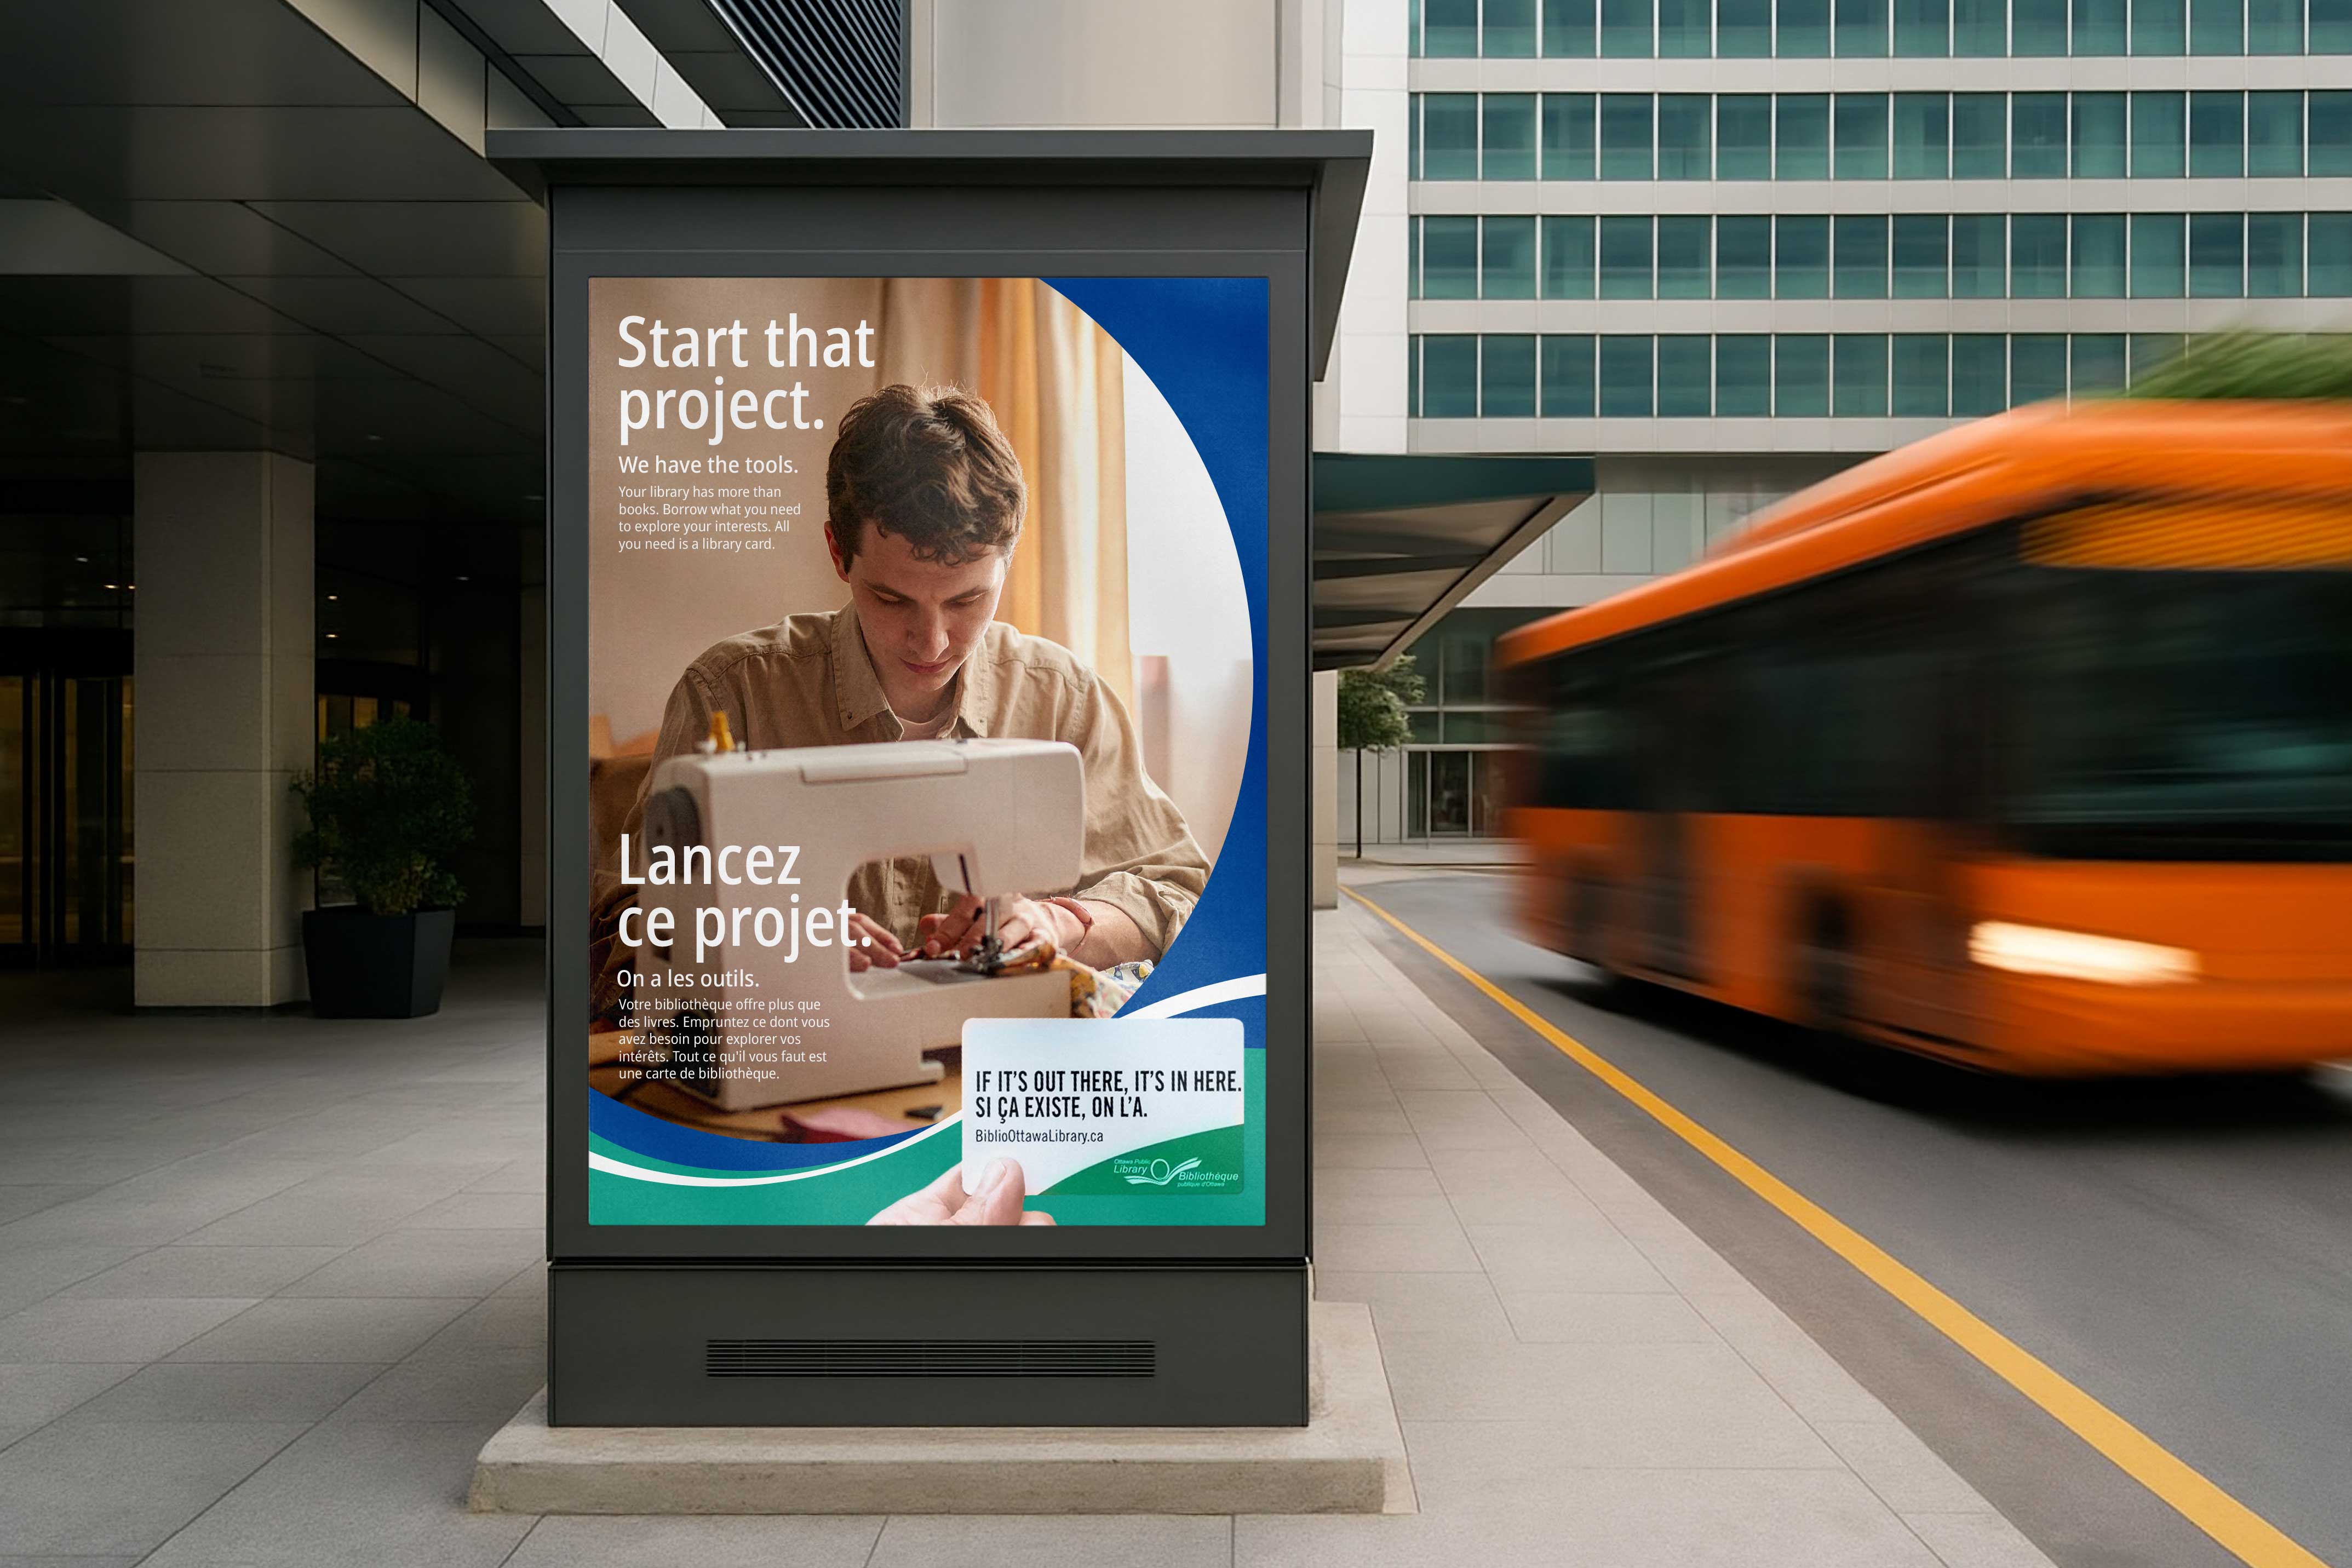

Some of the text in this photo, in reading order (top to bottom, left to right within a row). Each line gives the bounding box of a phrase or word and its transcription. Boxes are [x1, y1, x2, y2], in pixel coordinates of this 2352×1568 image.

[618, 313, 875, 368] Start that
[621, 376, 824, 446] project.
[618, 455, 798, 474] We have the tools.
[618, 485, 781, 501] Your library has more than
[619, 503, 800, 518] books. Borrow what you need
[618, 520, 789, 535] to explore your interests. All
[618, 537, 775, 553] you need is a library card.
[621, 834, 801, 886] Lancez
[619, 893, 871, 963] ce projet.
[617, 968, 759, 987] On a les outils.
[618, 998, 821, 1013] Votre bibliothèque offre plus que
[619, 1015, 830, 1031] des livres. Empruntez ce dont vous
[619, 1032, 801, 1048] avez besoin pour explorer vos
[619, 1050, 827, 1065] intérêts. Tout ce qu'il vous faut est
[619, 1067, 779, 1082] une carte de bibliothèque.
[977, 1070, 1241, 1095] IF IT'S OUT THERE, IT'S IN HERE.
[976, 1096, 1148, 1124] SI ÇA EXISTE, ON L'A.
[976, 1129, 1103, 1144] BiblioOttawaLibrary.ca
[1114, 1165, 1148, 1175] Library
[1179, 1172, 1238, 1181] Bibliothèque
